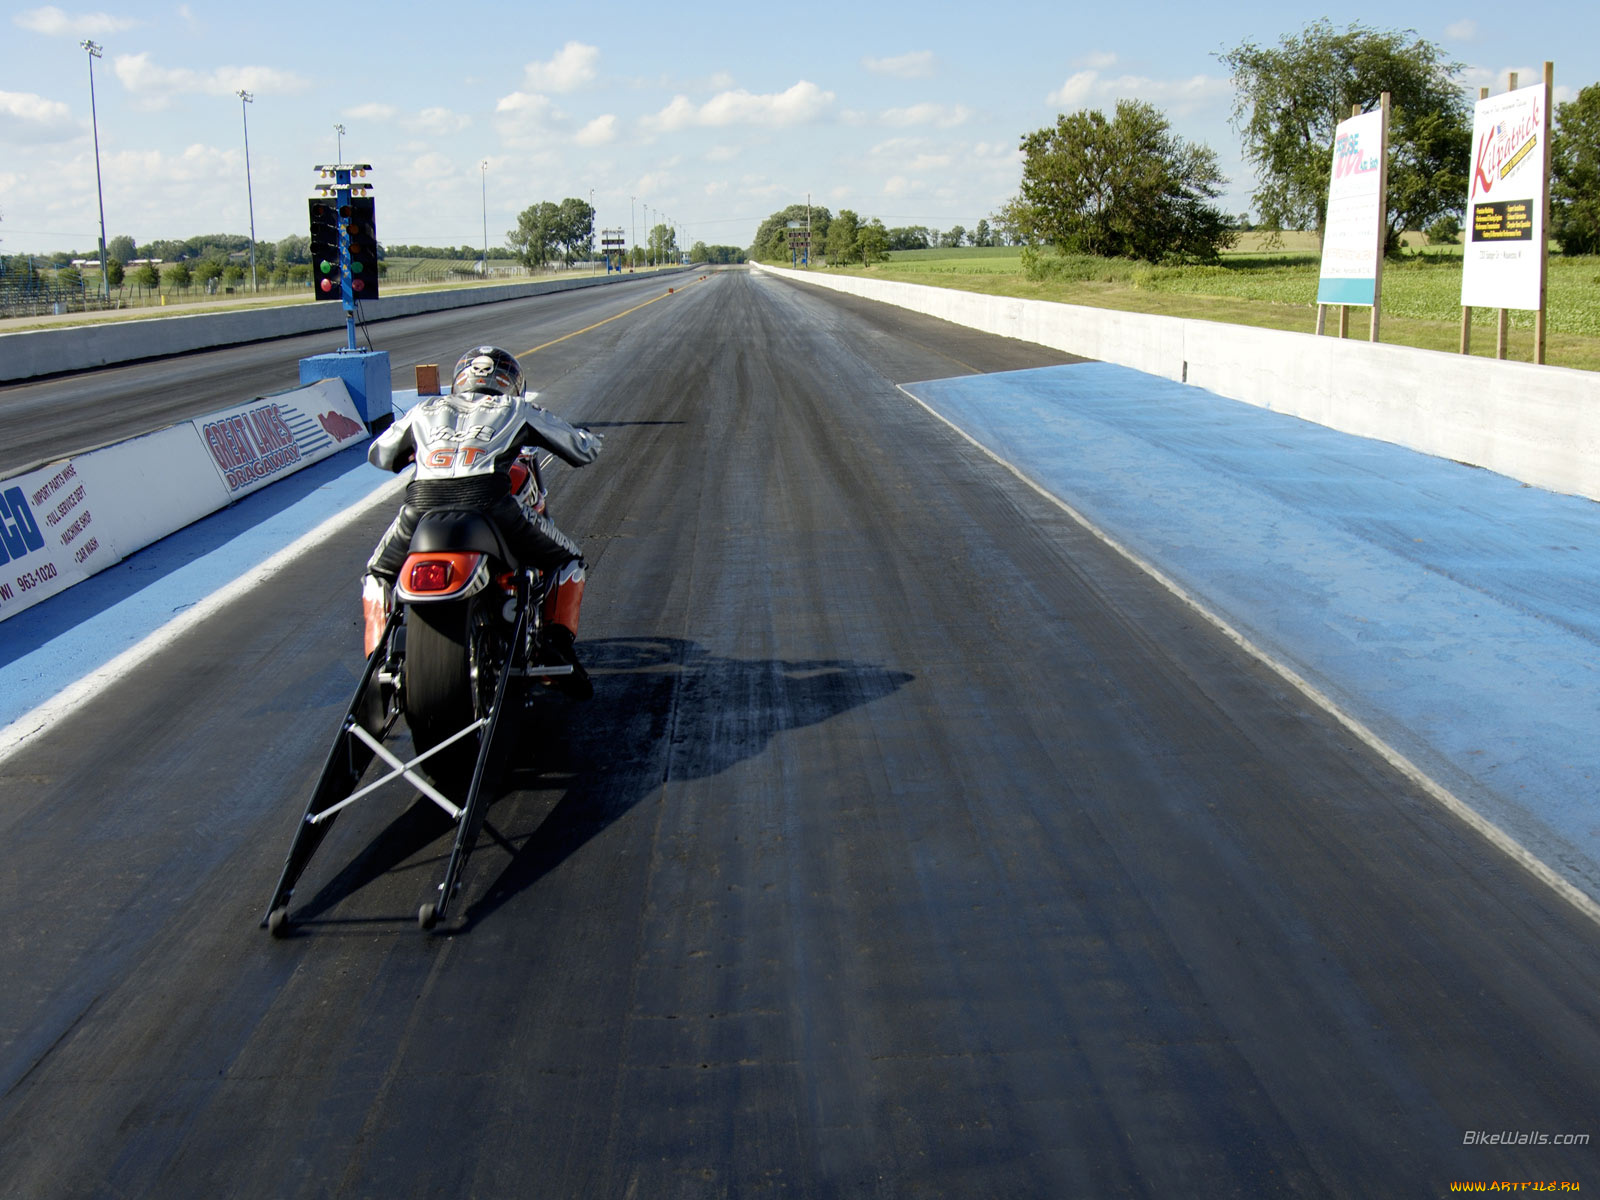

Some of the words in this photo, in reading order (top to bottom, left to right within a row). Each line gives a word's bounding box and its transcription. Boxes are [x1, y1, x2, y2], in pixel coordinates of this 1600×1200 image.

[1471, 96, 1540, 201] Kilpatrick
[203, 415, 257, 471] GREAT
[242, 403, 295, 456] LAKES
[426, 447, 486, 469] GT
[33, 484, 52, 507] IMPORT
[48, 474, 64, 495] PARTS
[62, 464, 76, 485] WHSE
[224, 442, 301, 491] DRAGAWAY
[47, 510, 61, 527] FULL
[58, 494, 75, 517] SERVICE
[73, 485, 87, 505] DEPT
[61, 520, 83, 545] MACHINE
[79, 510, 92, 531] SHOP
[76, 545, 88, 563] CAR
[85, 536, 100, 556] WASH
[17, 563, 57, 592] 963-1020
